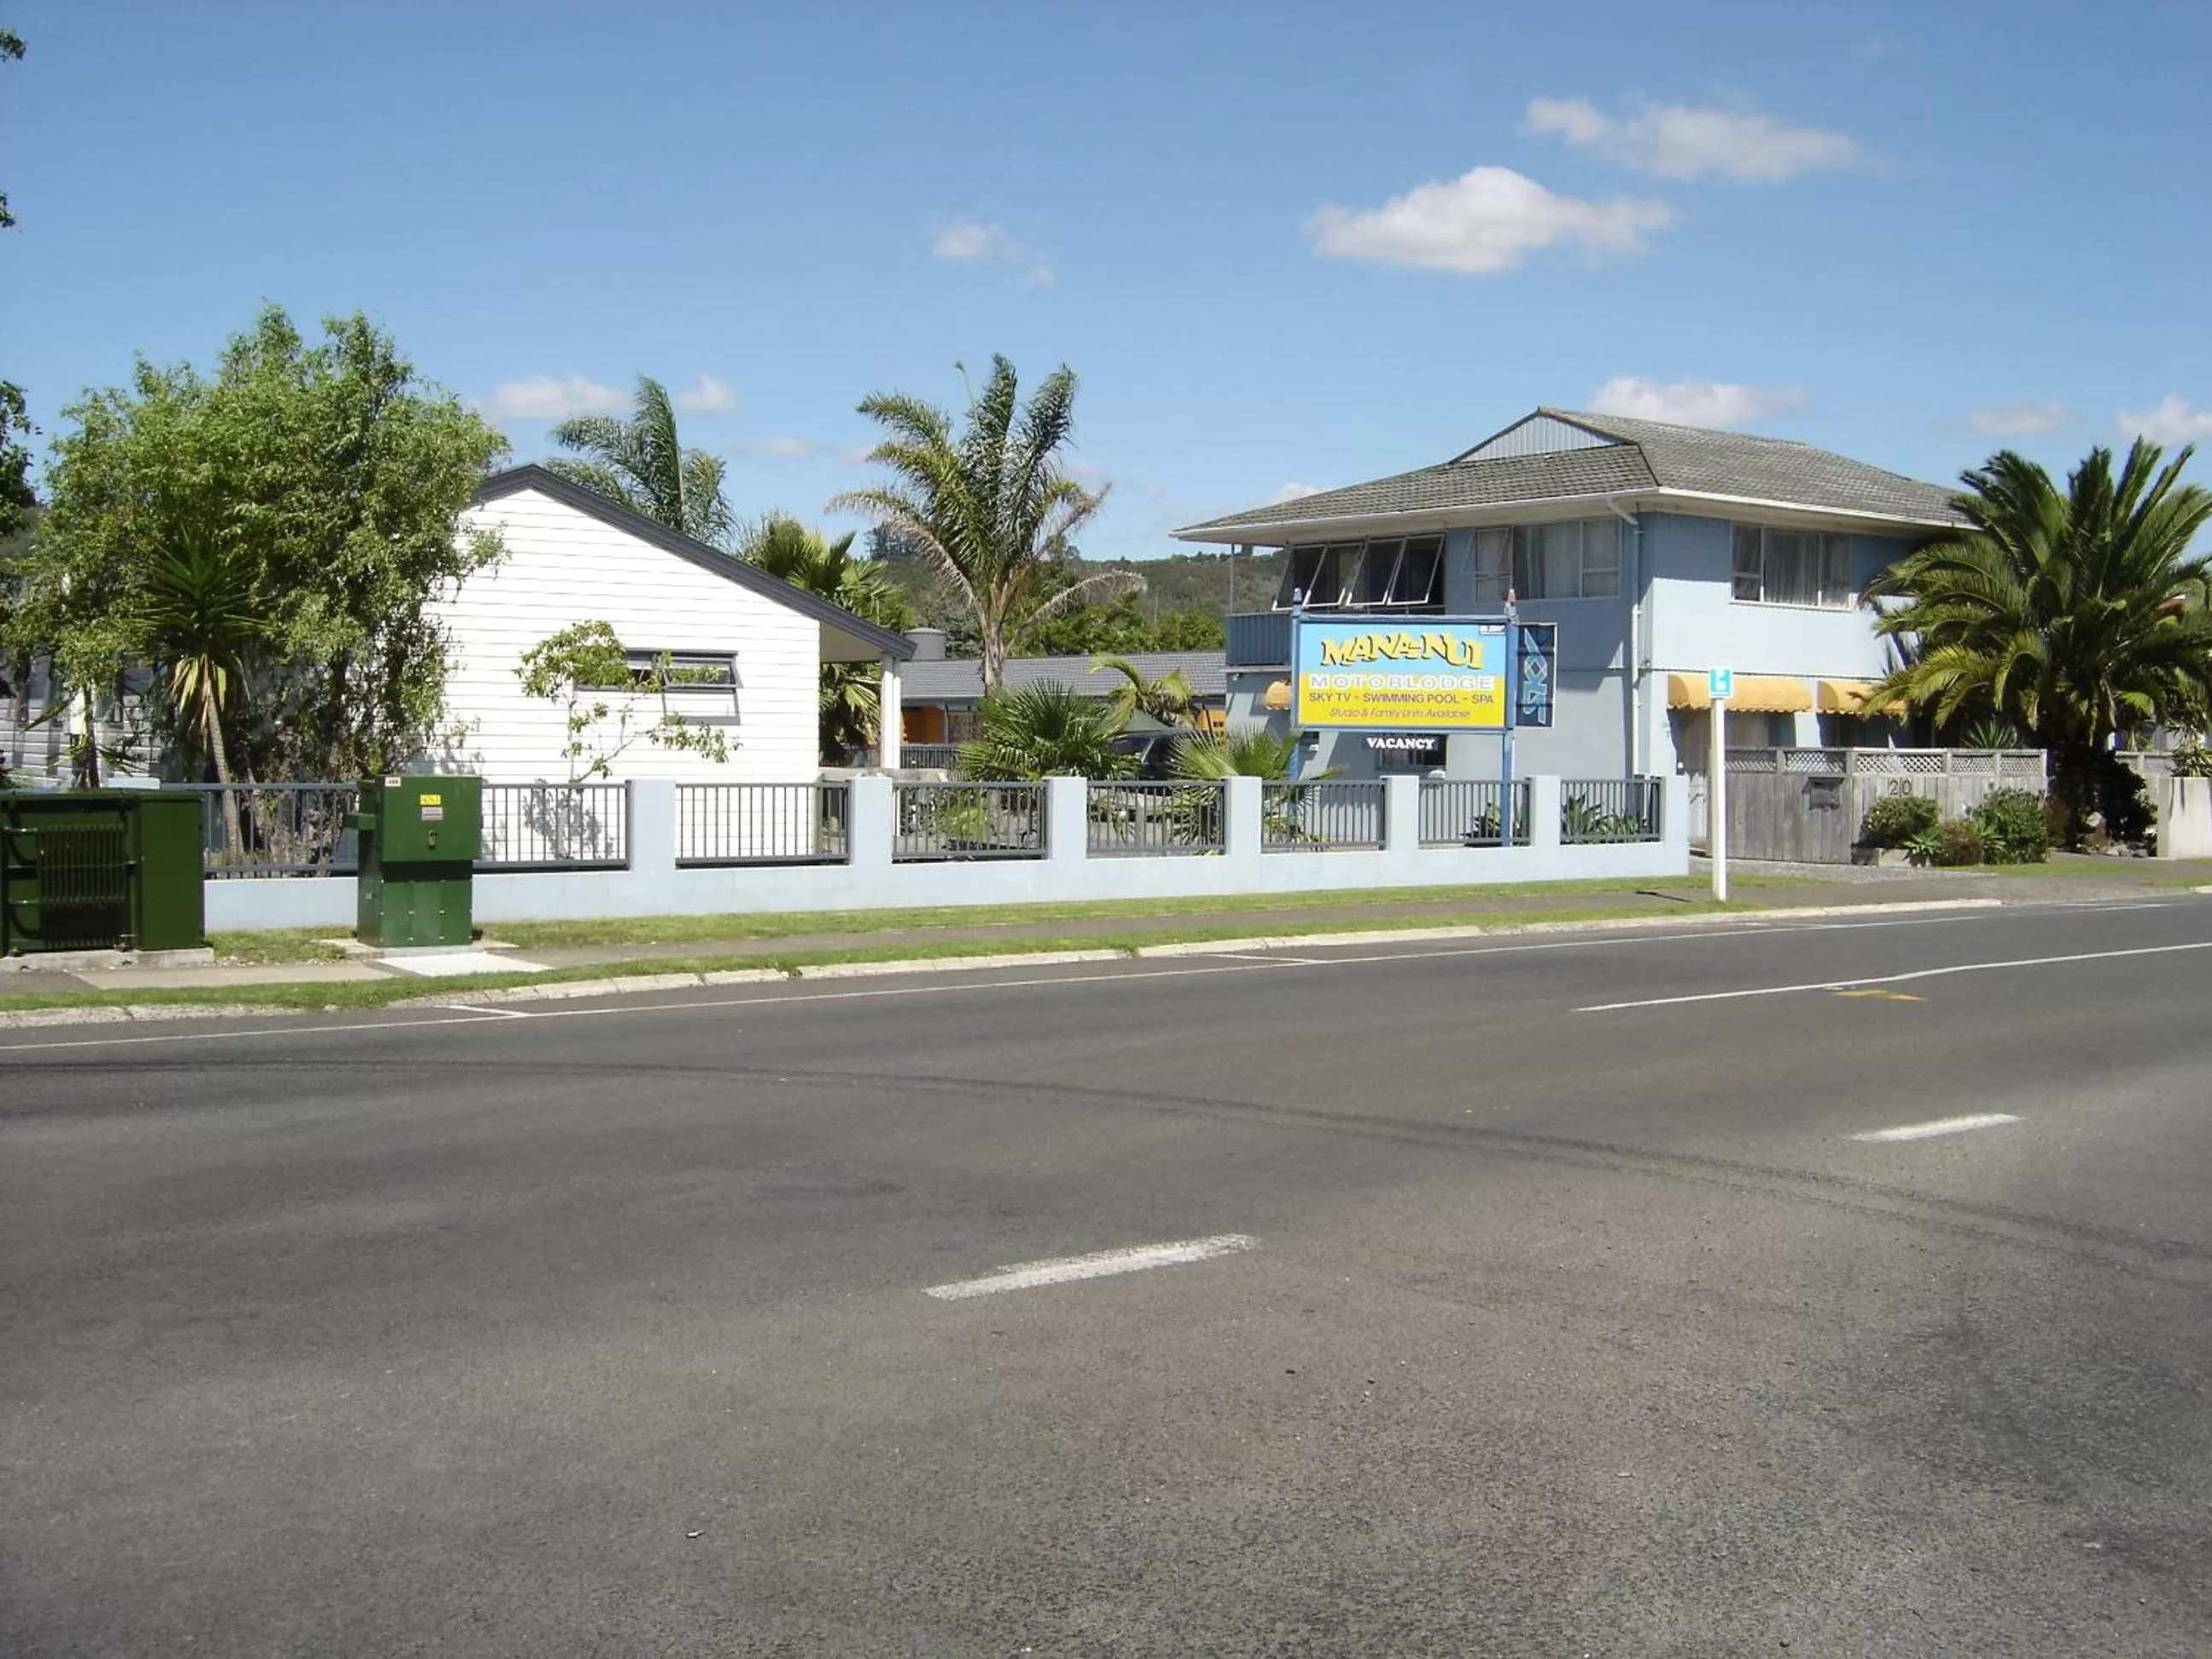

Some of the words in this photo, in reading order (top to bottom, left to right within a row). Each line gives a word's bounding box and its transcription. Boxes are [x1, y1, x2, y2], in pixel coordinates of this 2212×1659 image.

[1309, 673, 1495, 690] MOTORLODGE
[1309, 692, 1331, 702] SKY
[1335, 692, 1351, 702] TV
[1364, 692, 1424, 703] SWIMMING
[1427, 693, 1460, 704] POOL
[1471, 694, 1494, 704] SPA
[1330, 707, 1359, 718] Studio
[1370, 707, 1400, 719] Family
[1425, 708, 1471, 718] Available
[1366, 736, 1435, 751] VACANCY
[1889, 778, 1912, 795] 20
